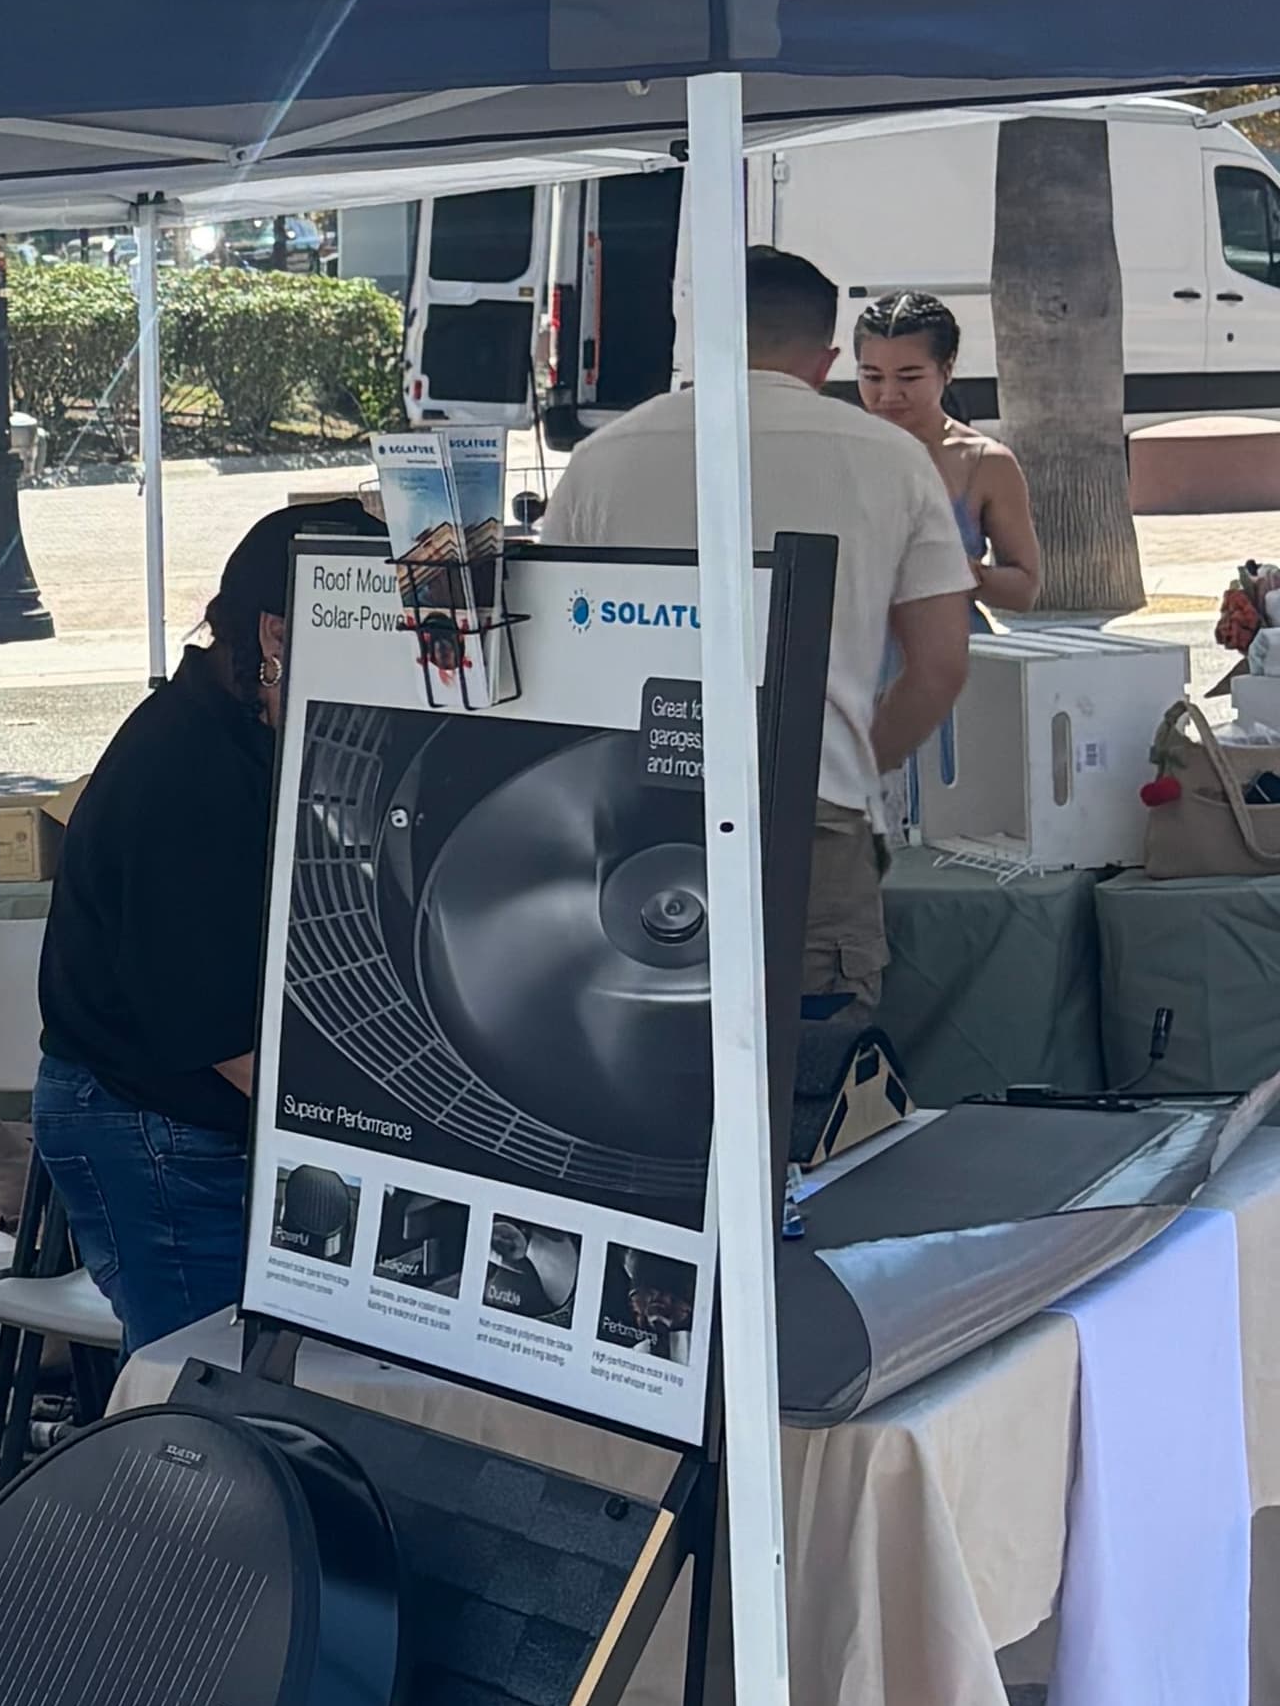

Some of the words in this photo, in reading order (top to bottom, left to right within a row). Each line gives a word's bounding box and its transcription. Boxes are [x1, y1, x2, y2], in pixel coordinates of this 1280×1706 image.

[314, 566, 353, 592] Roof
[651, 695, 687, 719] Great
[647, 755, 673, 774] and
[284, 1094, 334, 1123] Superior
[336, 1105, 413, 1141] Performance
[488, 1284, 521, 1306] Durable
[601, 1315, 659, 1345] Performance
